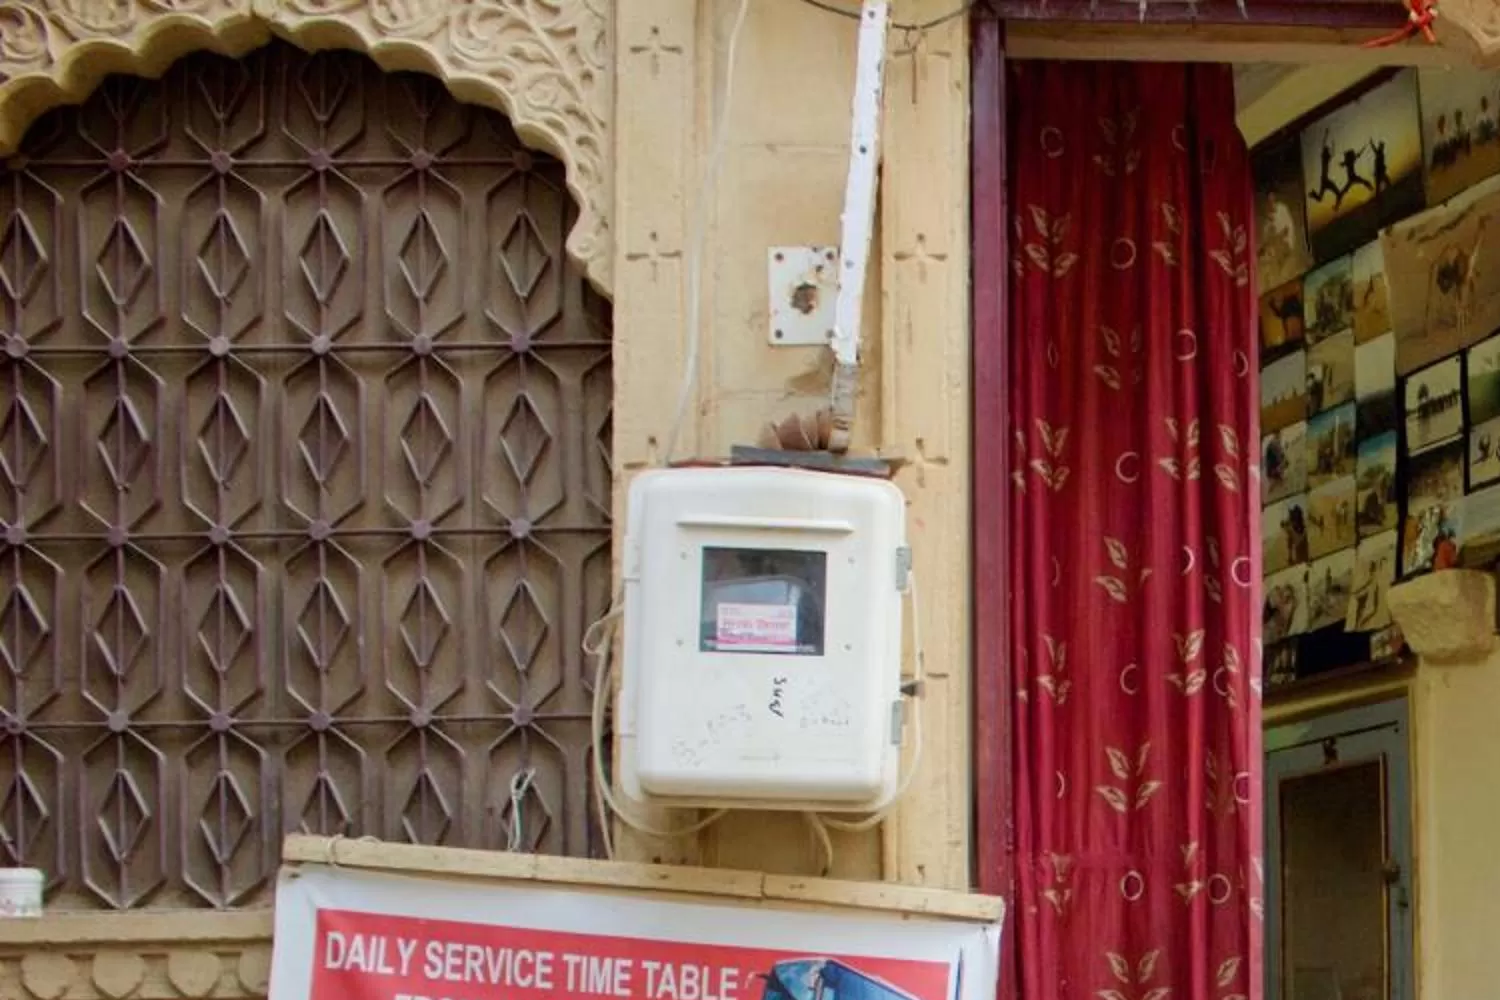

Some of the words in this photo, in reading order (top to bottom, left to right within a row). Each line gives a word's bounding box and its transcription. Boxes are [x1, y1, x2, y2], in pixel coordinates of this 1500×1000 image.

[325, 930, 415, 975] DAILY
[424, 943, 552, 989] SERVICE
[562, 953, 632, 997] TIME
